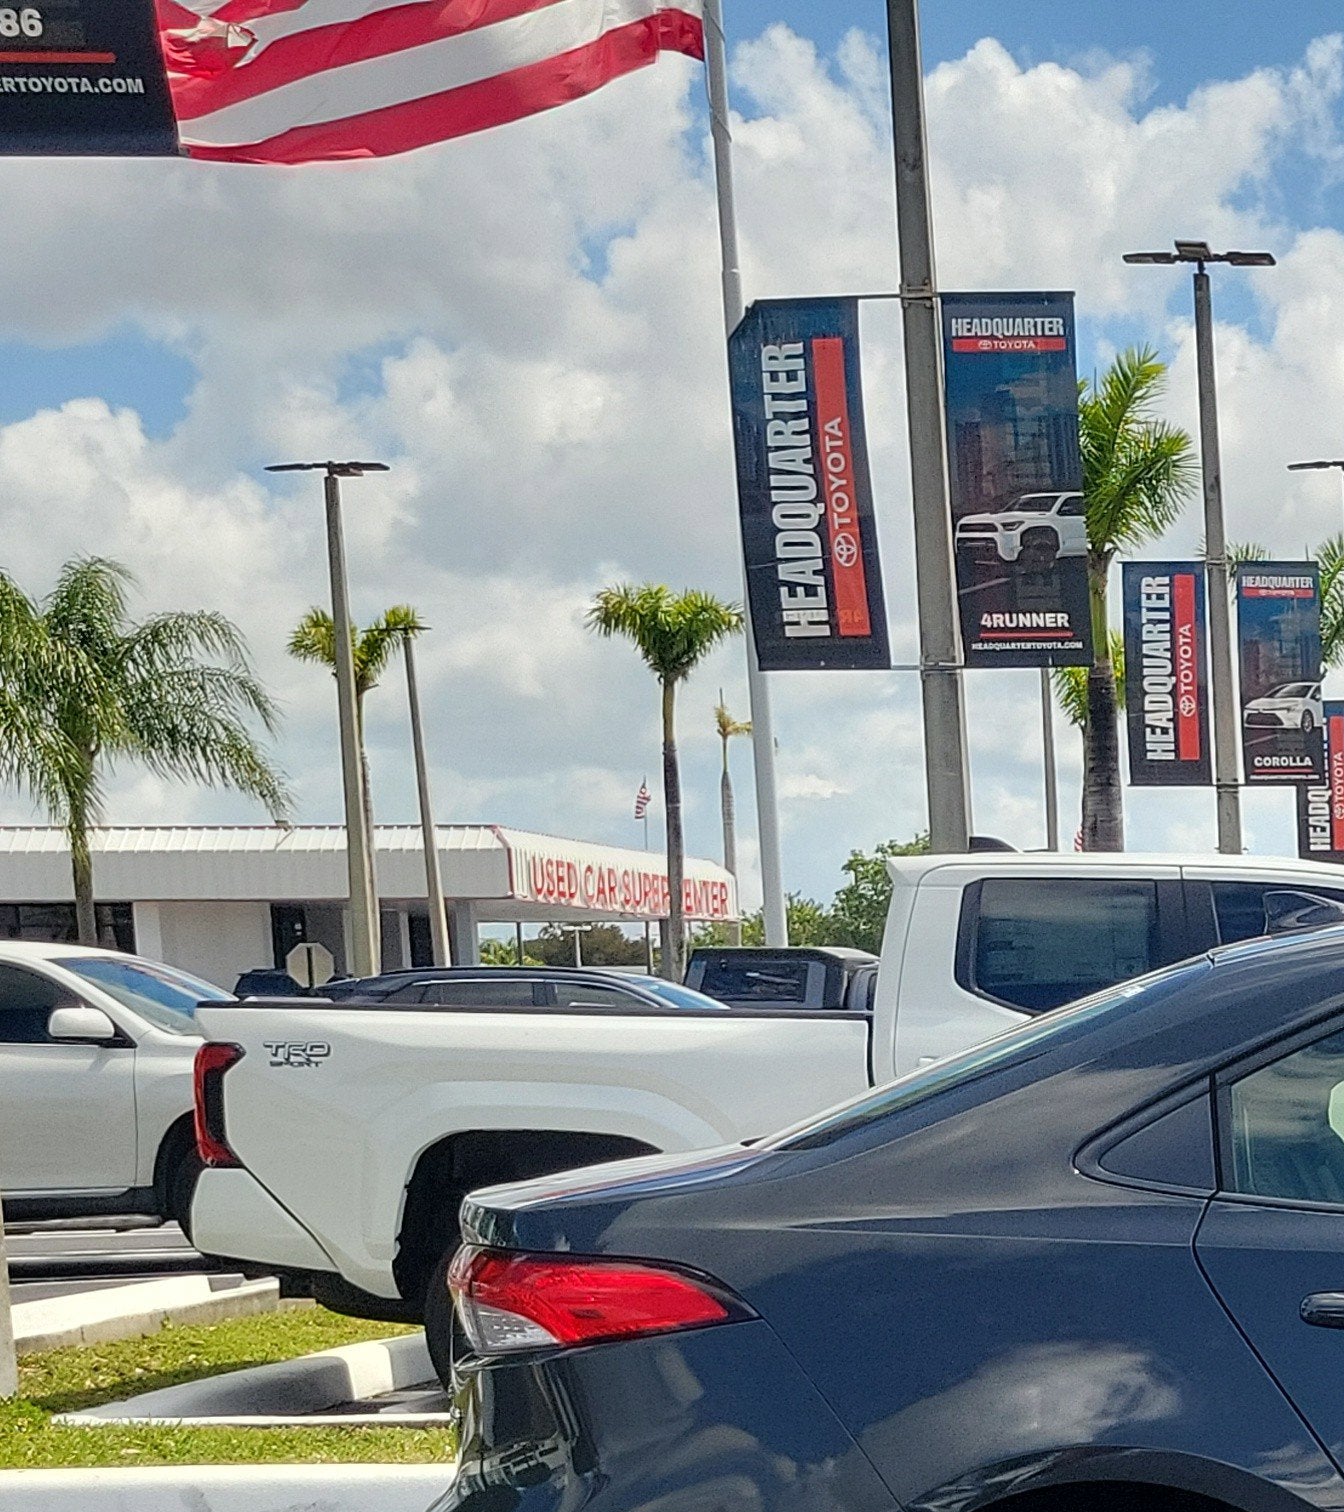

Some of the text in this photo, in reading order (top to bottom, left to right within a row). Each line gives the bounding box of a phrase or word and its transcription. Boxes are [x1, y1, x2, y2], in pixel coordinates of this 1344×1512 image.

[0, 8, 43, 38] 86
[952, 317, 1064, 338] HEADQUARTER
[993, 339, 1036, 349] TOYOTA
[823, 416, 851, 530] TOYOTA
[761, 341, 832, 638] HEADQUARTER
[1242, 576, 1313, 589] HEADQUARTER
[980, 613, 1070, 628] 4RUNNER
[1140, 575, 1176, 761] HEADQUARTER
[1177, 624, 1194, 692] TOYOTA
[1254, 756, 1313, 766] COROLLA
[1334, 752, 1344, 804] TOYOTA
[532, 855, 729, 915] USED CAR SUPERENTER
[263, 1041, 331, 1062] TRD
